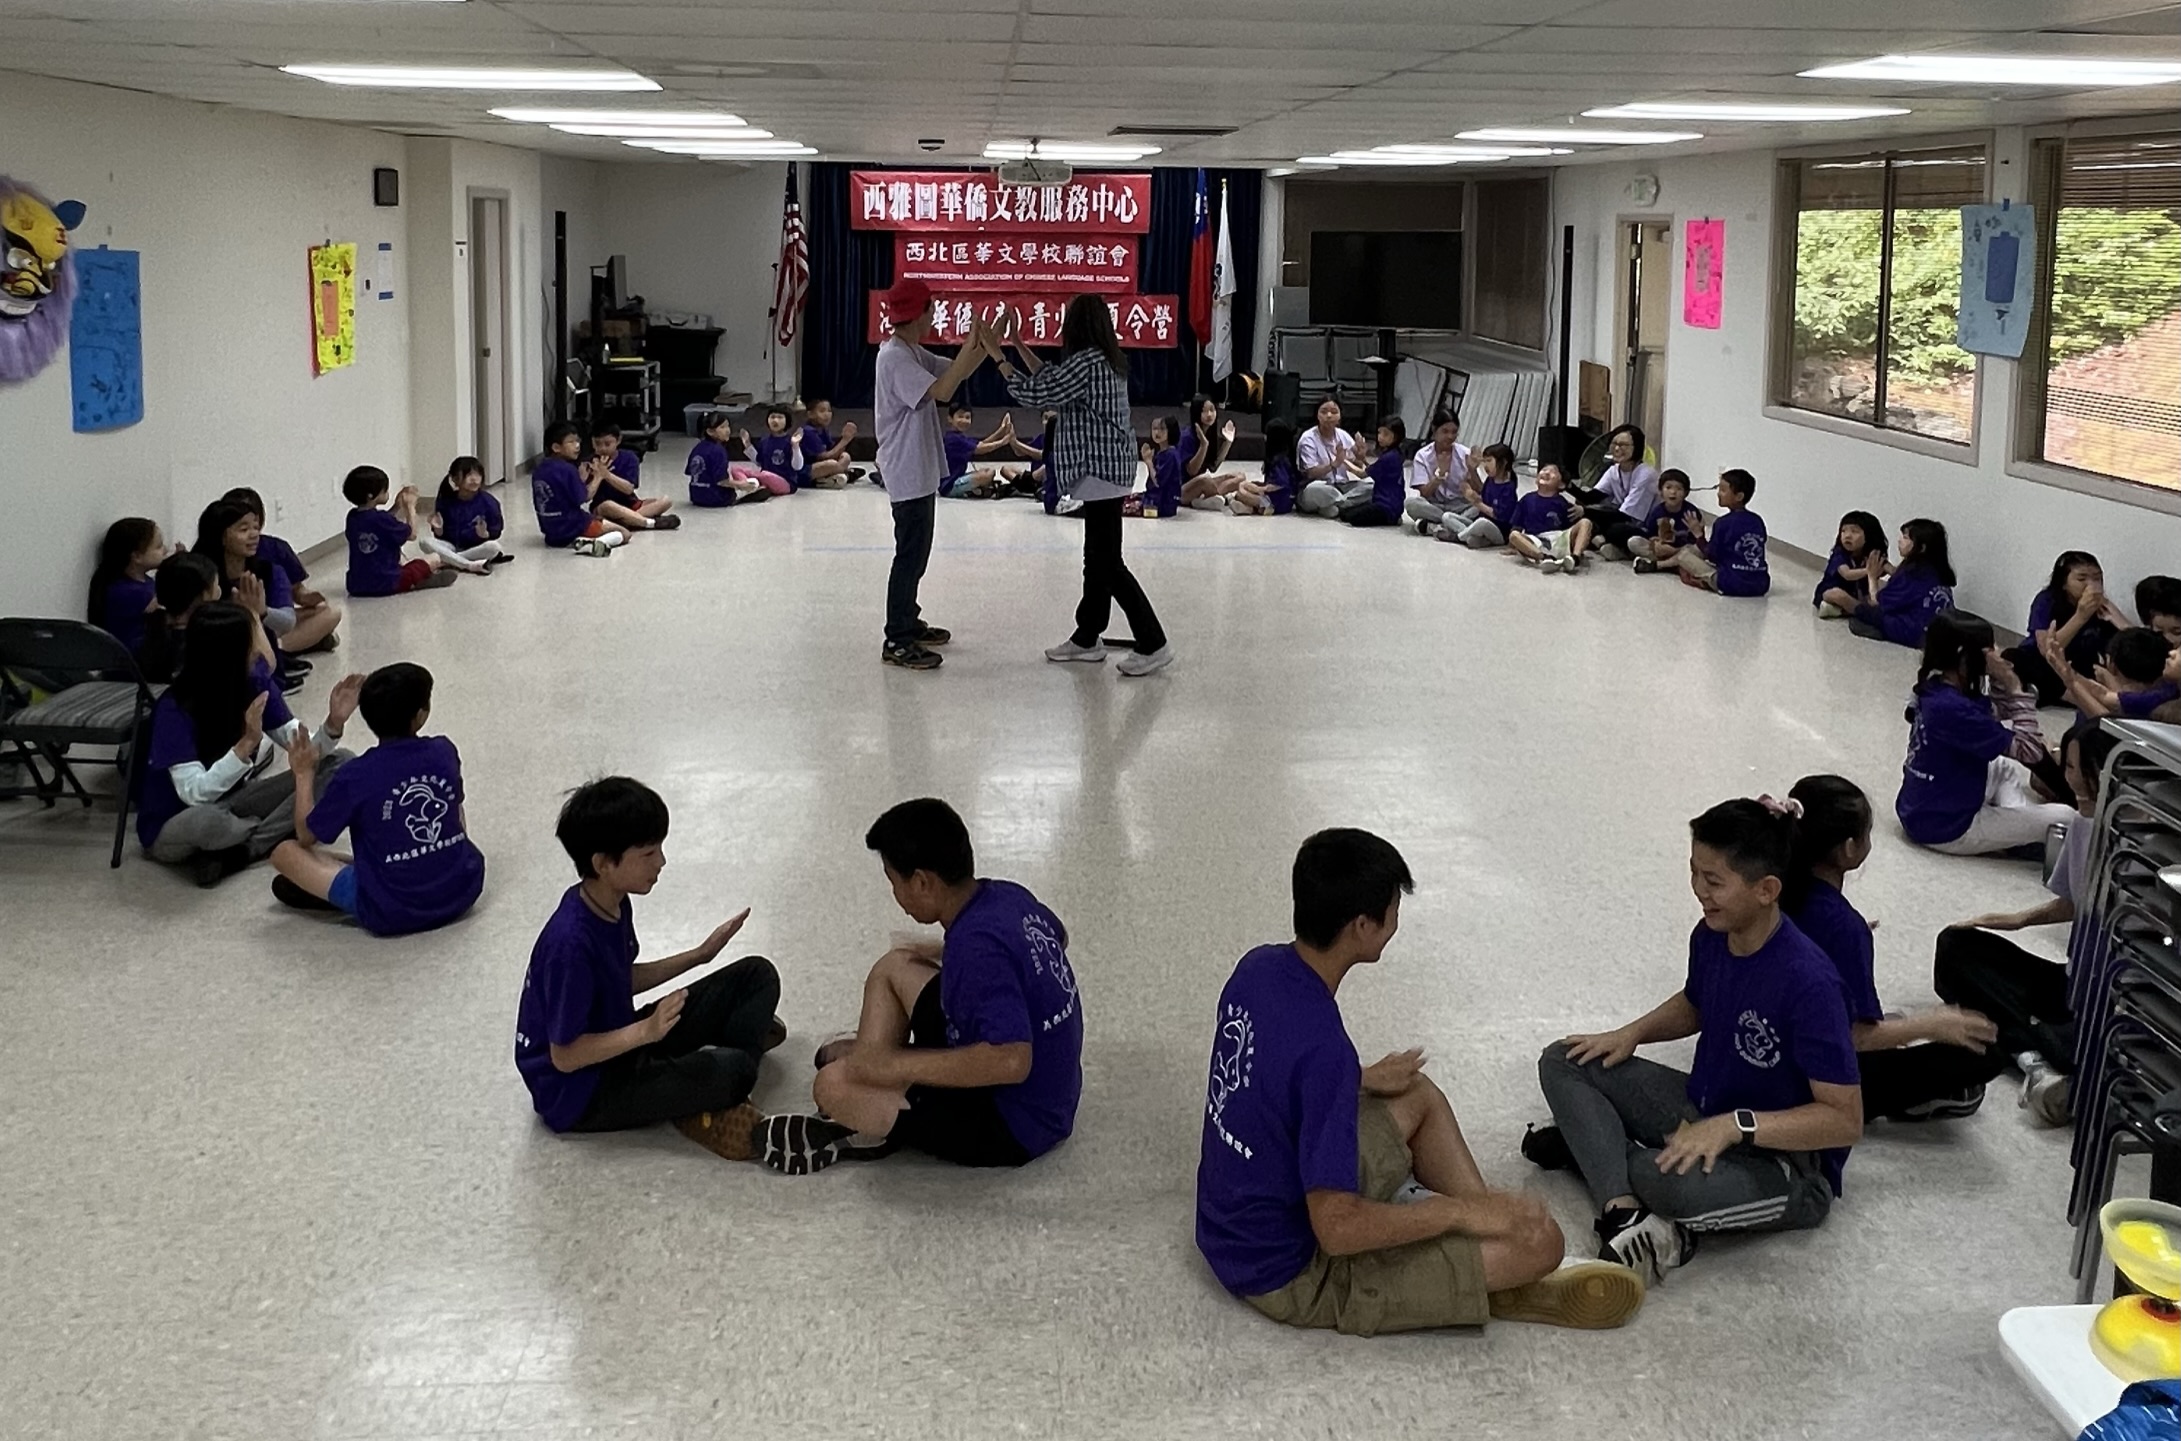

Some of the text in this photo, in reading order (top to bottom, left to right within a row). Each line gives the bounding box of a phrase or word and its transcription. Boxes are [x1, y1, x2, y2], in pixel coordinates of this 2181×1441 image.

[863, 181, 1138, 223] 西雅圖華僑文教服務中心
[906, 241, 1129, 268] 西北區華文學校聯誼會
